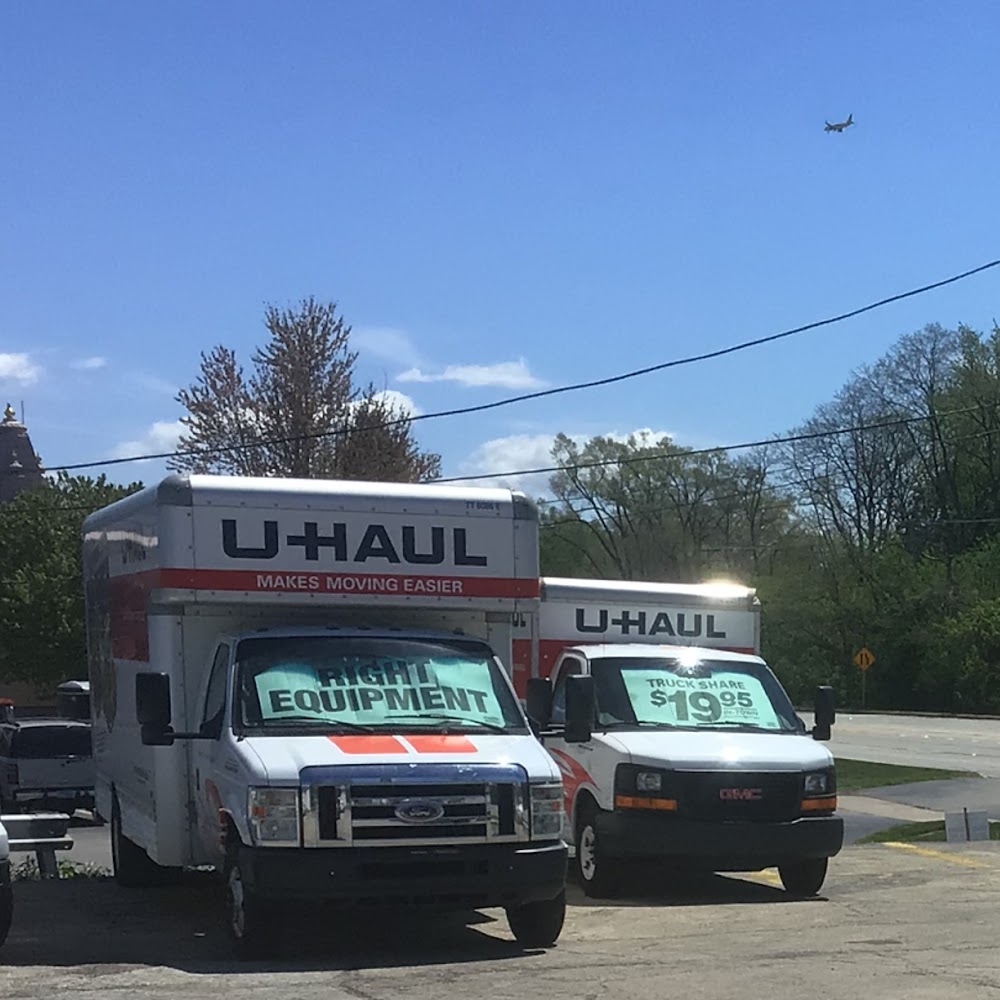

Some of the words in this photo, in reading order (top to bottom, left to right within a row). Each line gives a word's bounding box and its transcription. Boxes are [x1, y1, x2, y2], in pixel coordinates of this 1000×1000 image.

[221, 519, 487, 566] U-HAUL
[256, 574, 319, 591] MAKES
[326, 576, 399, 592] MOVING
[403, 578, 463, 594] EASIER
[575, 608, 726, 638] U-HAUL
[318, 658, 435, 688] RIGHT
[646, 678, 695, 689] TRUCK
[699, 679, 746, 690] SHARE
[268, 686, 488, 714] EQUIPMENT
